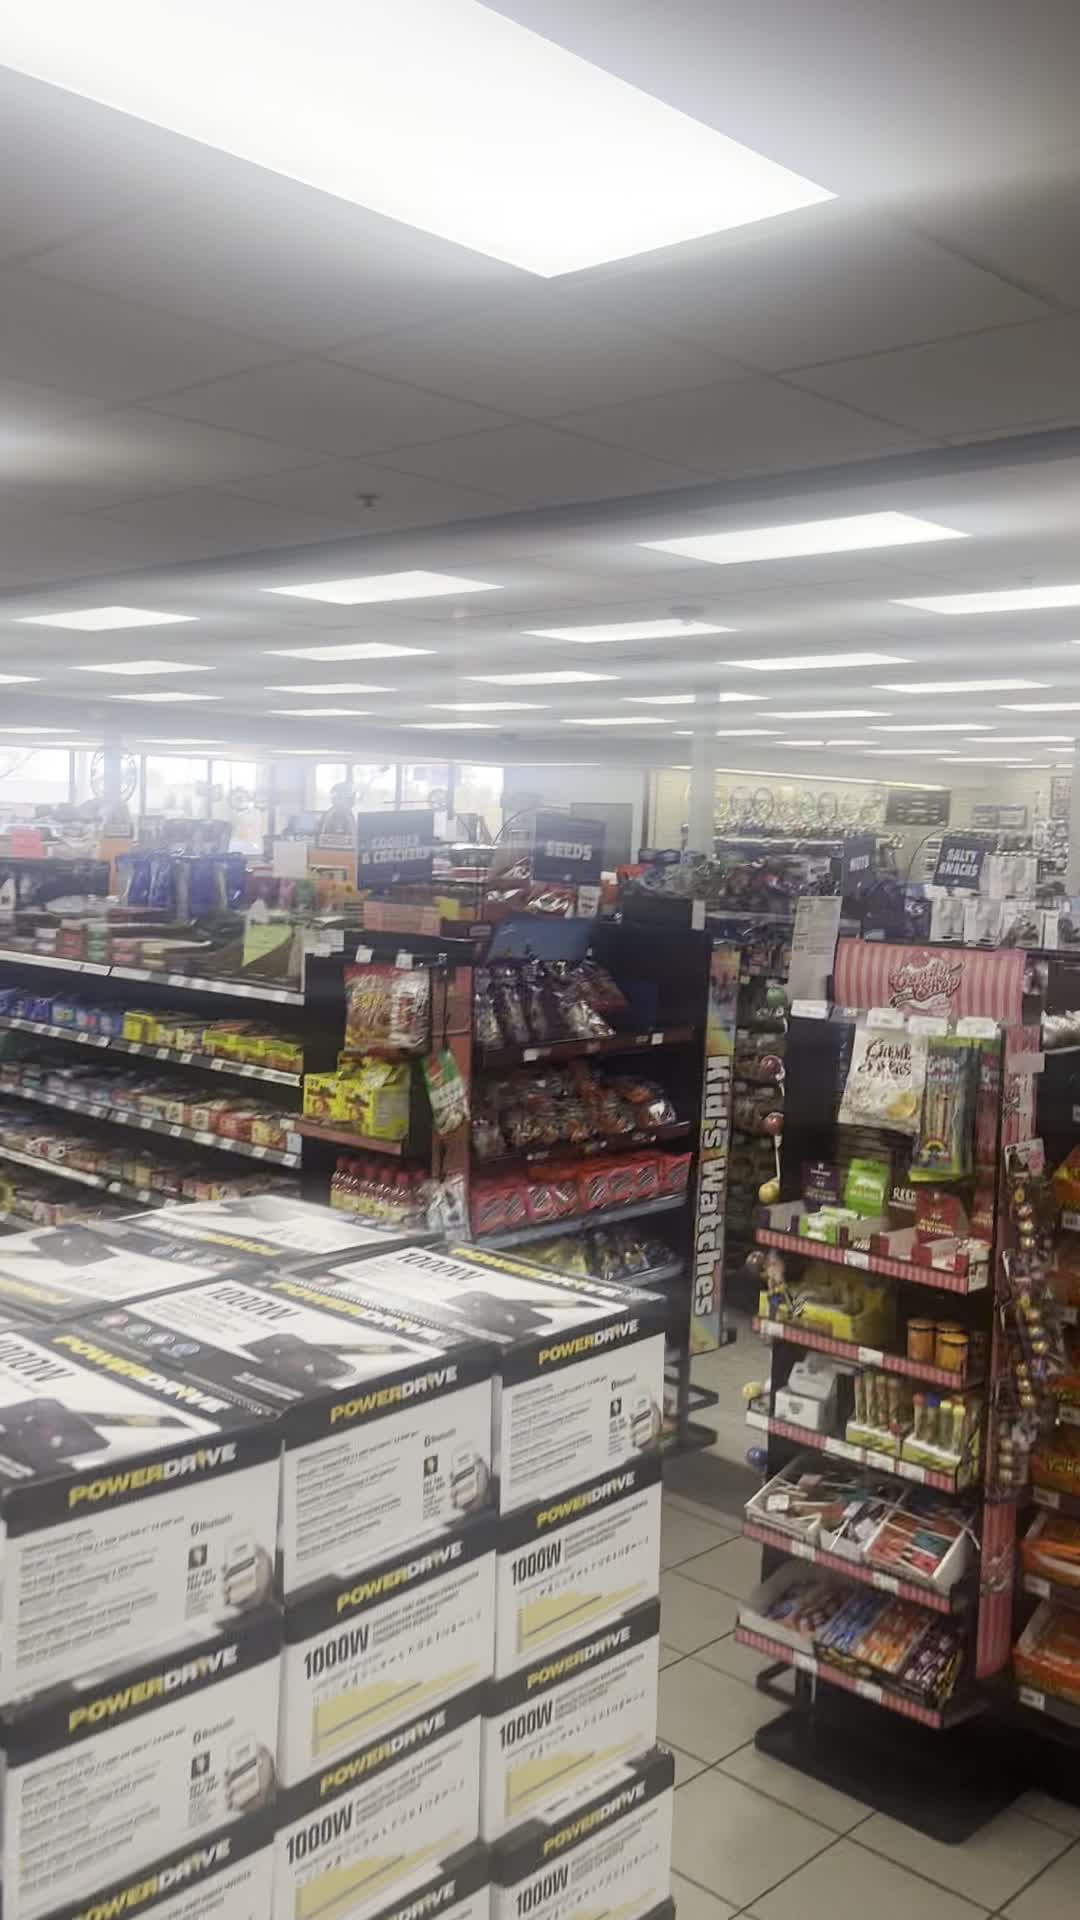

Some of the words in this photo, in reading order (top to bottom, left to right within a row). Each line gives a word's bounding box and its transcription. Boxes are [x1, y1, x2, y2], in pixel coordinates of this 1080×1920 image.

[545, 840, 593, 861] SEEDS
[938, 861, 979, 878] SNACKS
[947, 848, 977, 864] SALTY
[703, 1055, 731, 1149] Kid's
[397, 1252, 487, 1281] 1000W
[694, 1158, 726, 1317] Watches
[450, 1247, 623, 1298] POWERDRIVE
[207, 1287, 300, 1321] 1000W
[271, 1281, 443, 1341] POWERDRIVE
[538, 1319, 640, 1366] POWERDRIVE
[52, 1335, 231, 1413] POWERDRIVE
[330, 1366, 457, 1424] POWERDRIVE
[68, 1442, 237, 1507] POWERDRIVE
[537, 1471, 636, 1528] POWERDRIVE
[336, 1541, 463, 1613] POWERDRIVE
[512, 1539, 562, 1586] 1000W
[304, 1623, 369, 1681] 1000W
[527, 1625, 632, 1690] POWERDRIVE
[69, 1645, 238, 1734] POWERDRIVE
[320, 1710, 447, 1797] POWERDRIVE
[500, 1700, 553, 1750] 1000W
[286, 1800, 353, 1866] 1000W
[544, 1780, 646, 1857] POWERDRIVE
[516, 1863, 569, 1918] 1000W
